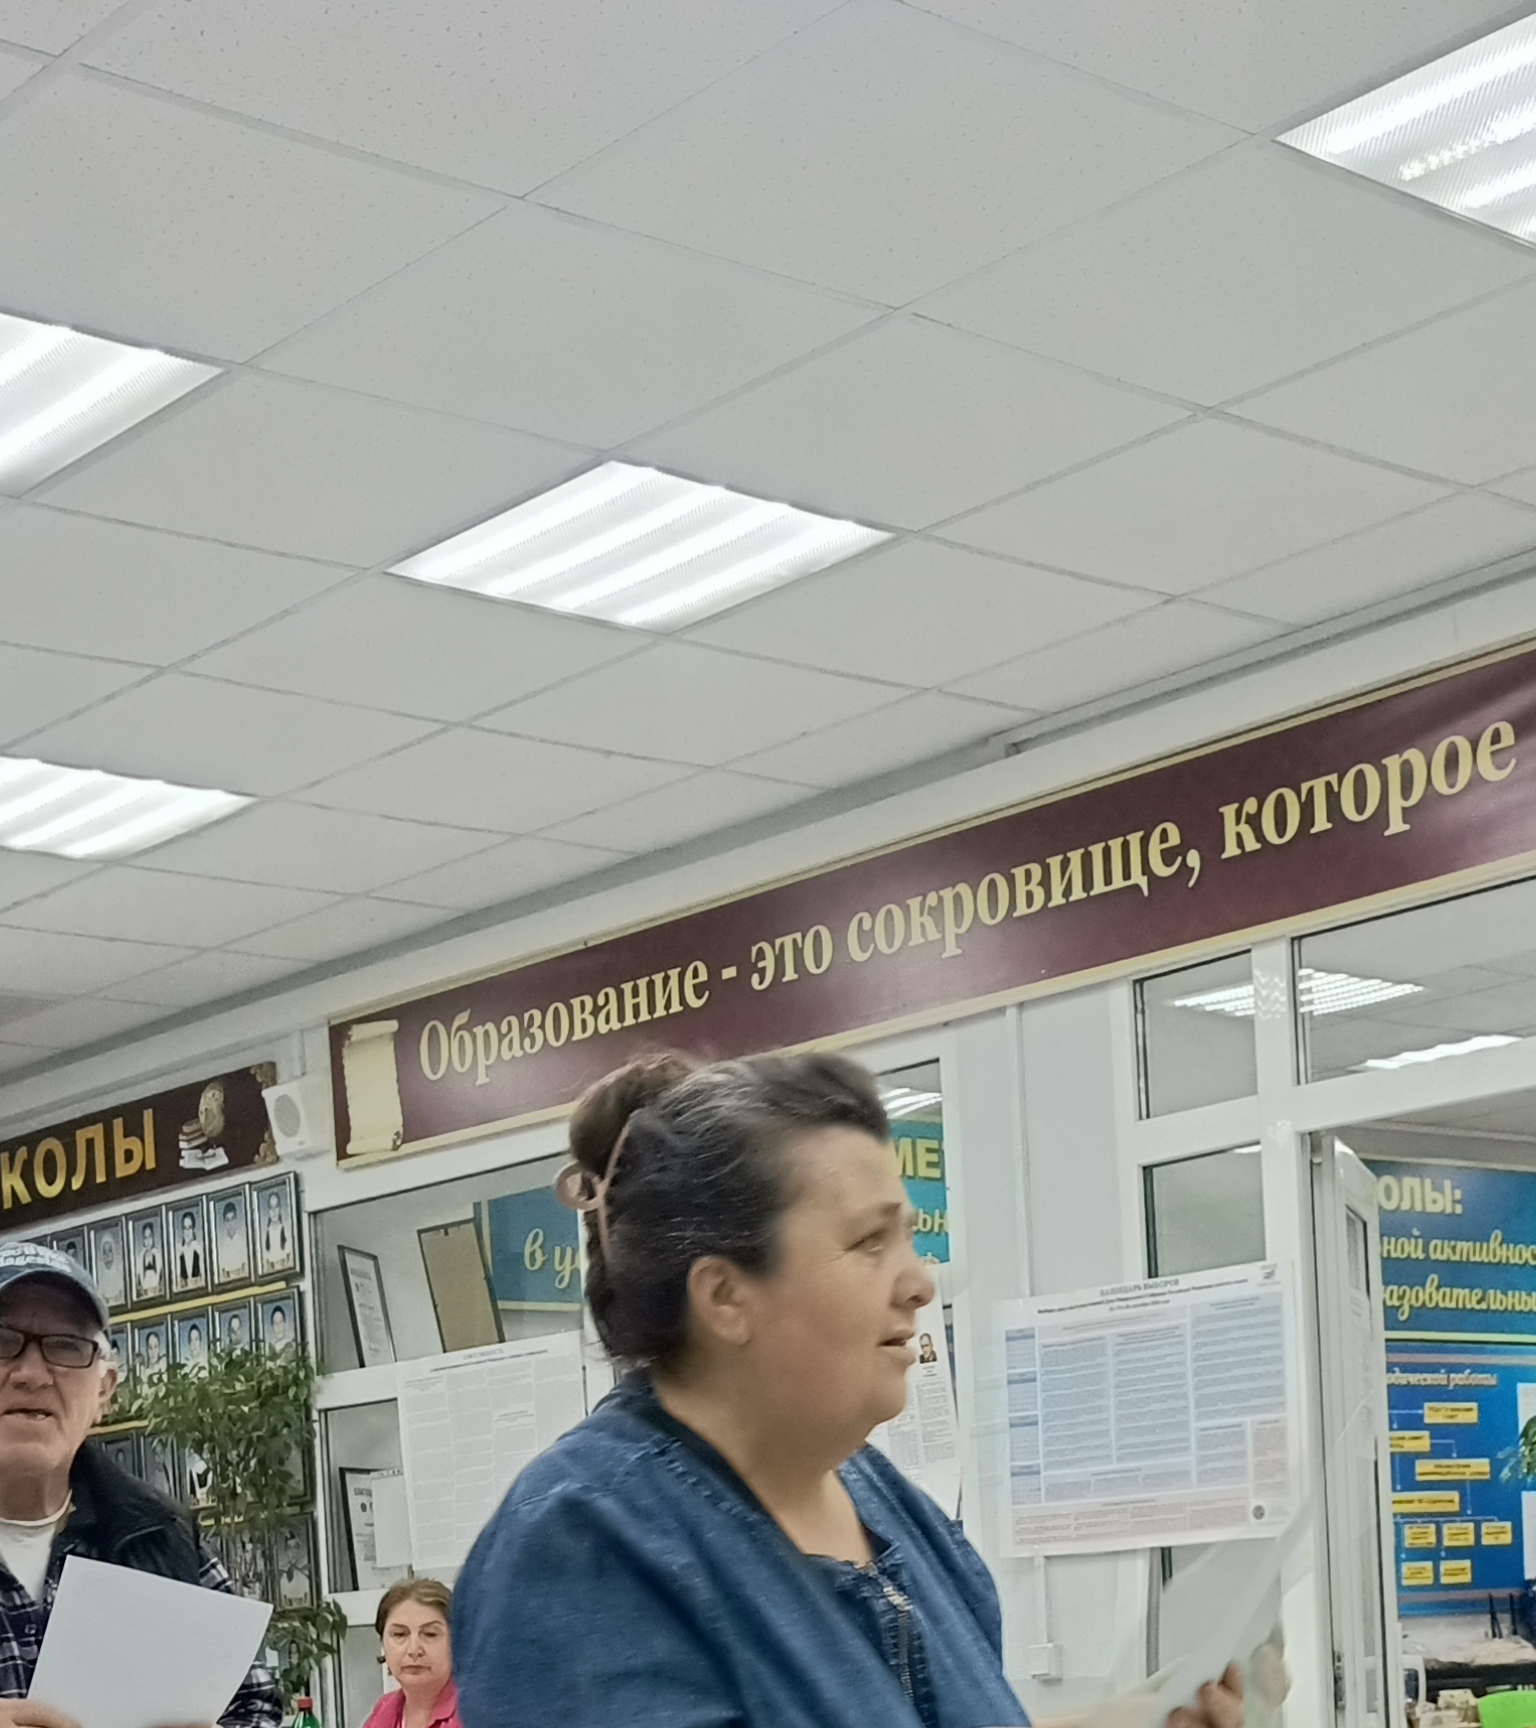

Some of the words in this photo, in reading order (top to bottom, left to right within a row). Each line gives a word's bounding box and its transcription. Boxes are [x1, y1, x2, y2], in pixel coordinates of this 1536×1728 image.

[420, 960, 709, 1086] Образование
[751, 924, 833, 991] это
[847, 821, 1202, 963] сокровище,
[1219, 721, 1517, 860] которое
[894, 1137, 944, 1179] МЕ
